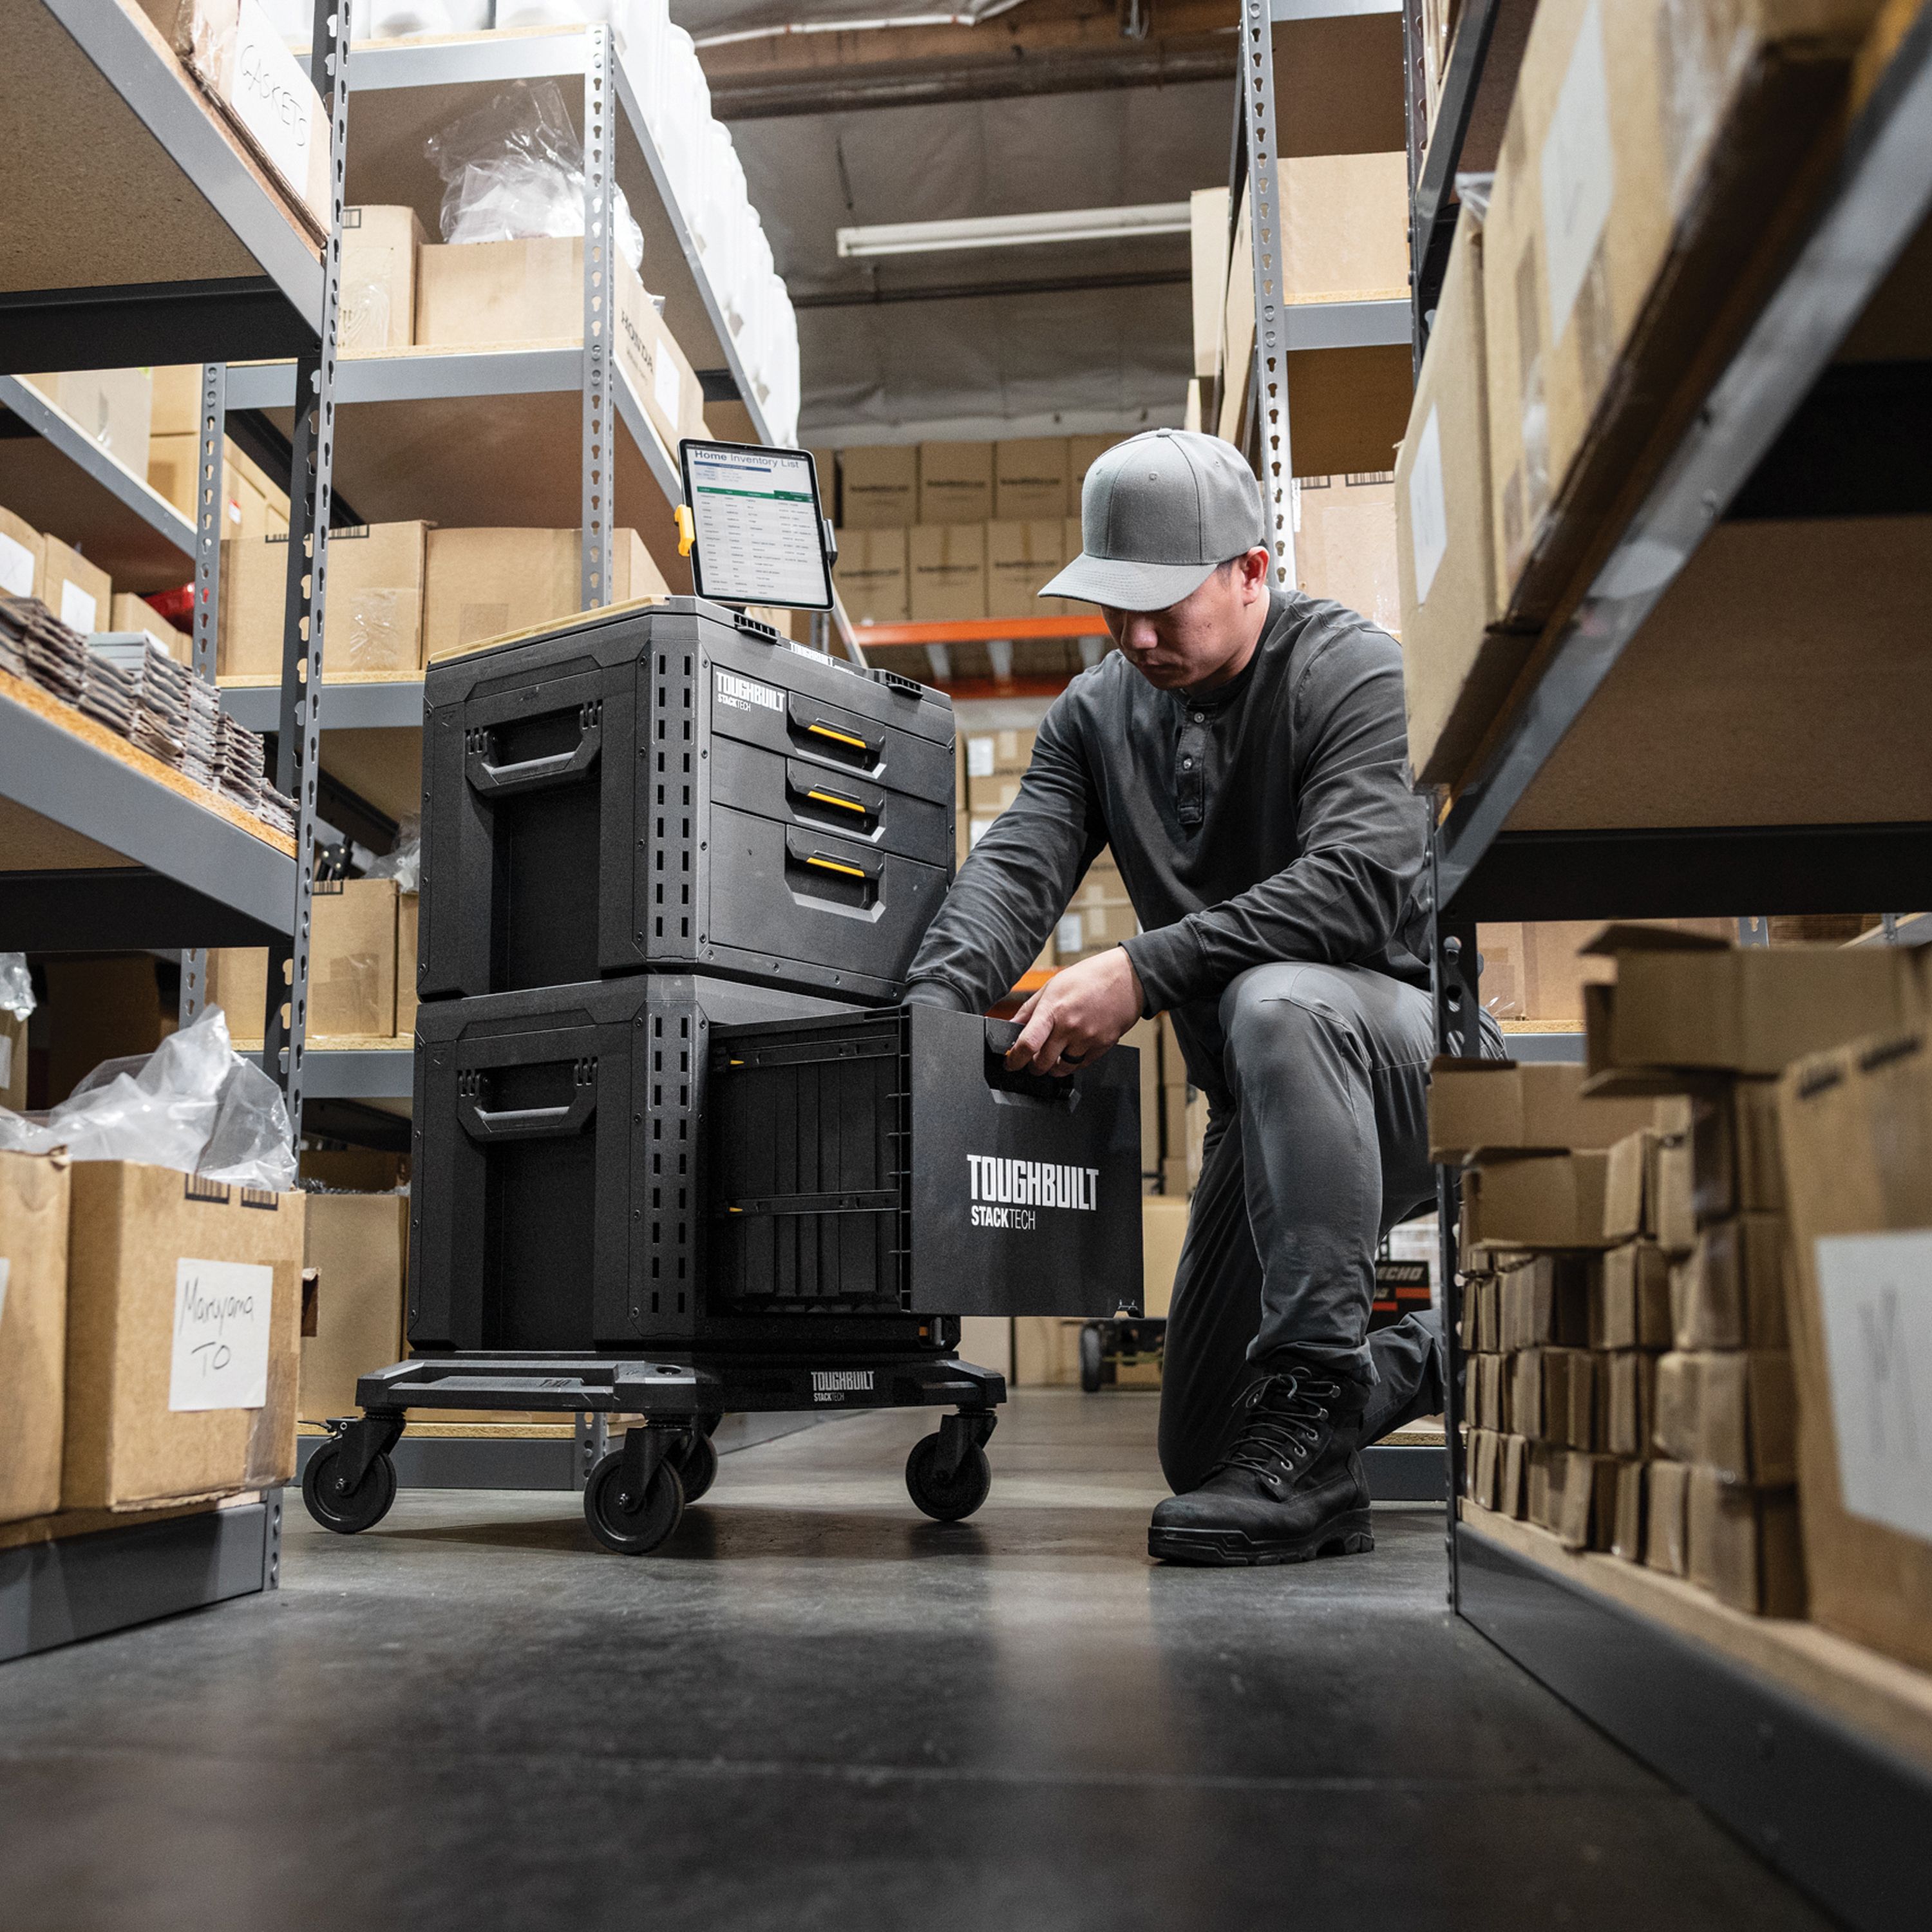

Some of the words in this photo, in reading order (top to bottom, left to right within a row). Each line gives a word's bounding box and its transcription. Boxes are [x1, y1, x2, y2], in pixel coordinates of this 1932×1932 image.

[240, 44, 307, 146] GASKETS
[621, 309, 654, 374] HONDA
[695, 450, 727, 460] Home
[731, 453, 778, 468] Inventory
[781, 459, 799, 468] List
[716, 672, 784, 712] TOUGHBUILT
[717, 694, 751, 712] STACKTECH
[967, 1154, 1099, 1211] TOUGHBUILT
[971, 1205, 1036, 1230] STACKTECH
[191, 1341, 232, 1378] TO
[811, 1371, 875, 1391] TOUGHBUILT
[813, 1392, 845, 1401] STACKTECH
